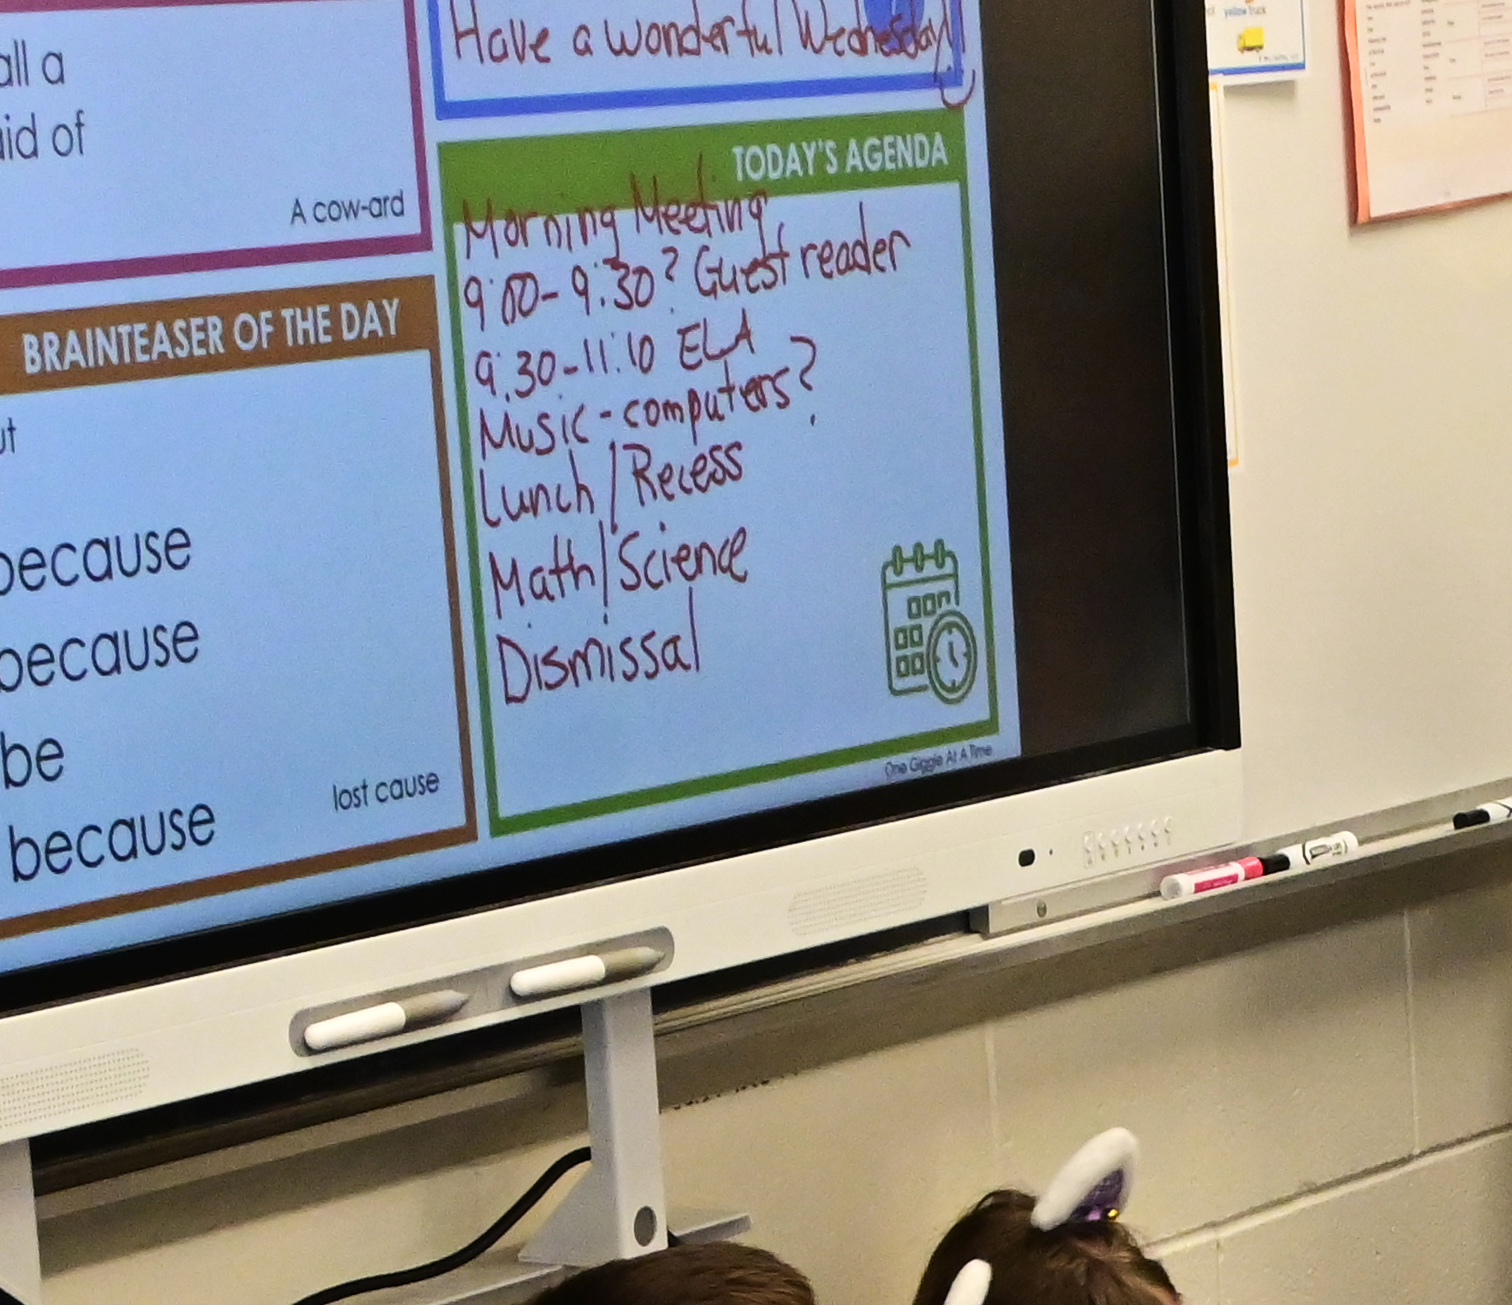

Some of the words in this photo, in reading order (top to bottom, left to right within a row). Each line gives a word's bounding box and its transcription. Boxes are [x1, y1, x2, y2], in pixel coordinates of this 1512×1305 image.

[455, 0, 549, 65] Have
[573, 28, 593, 57] a
[605, 0, 784, 58] wonderful
[42, 51, 65, 86] a
[0, 113, 39, 160] id
[52, 110, 85, 157] of
[733, 141, 838, 182] TODAY'S
[846, 132, 948, 172] AGENDA
[290, 198, 307, 226] A
[313, 190, 405, 225] cow-ard
[462, 197, 620, 263] Morning
[630, 160, 768, 258] Meeting
[694, 220, 790, 299] Guest
[800, 201, 912, 279] reader
[22, 315, 226, 375] BRAINTEASER
[232, 311, 274, 352] OF
[282, 304, 333, 348] THE
[341, 298, 401, 341] DAY
[676, 307, 756, 372] ELA
[496, 587, 701, 705] Dismissal
[0, 730, 65, 789] be
[332, 779, 370, 812] lost
[375, 770, 441, 805] cause
[8, 802, 216, 884] because
